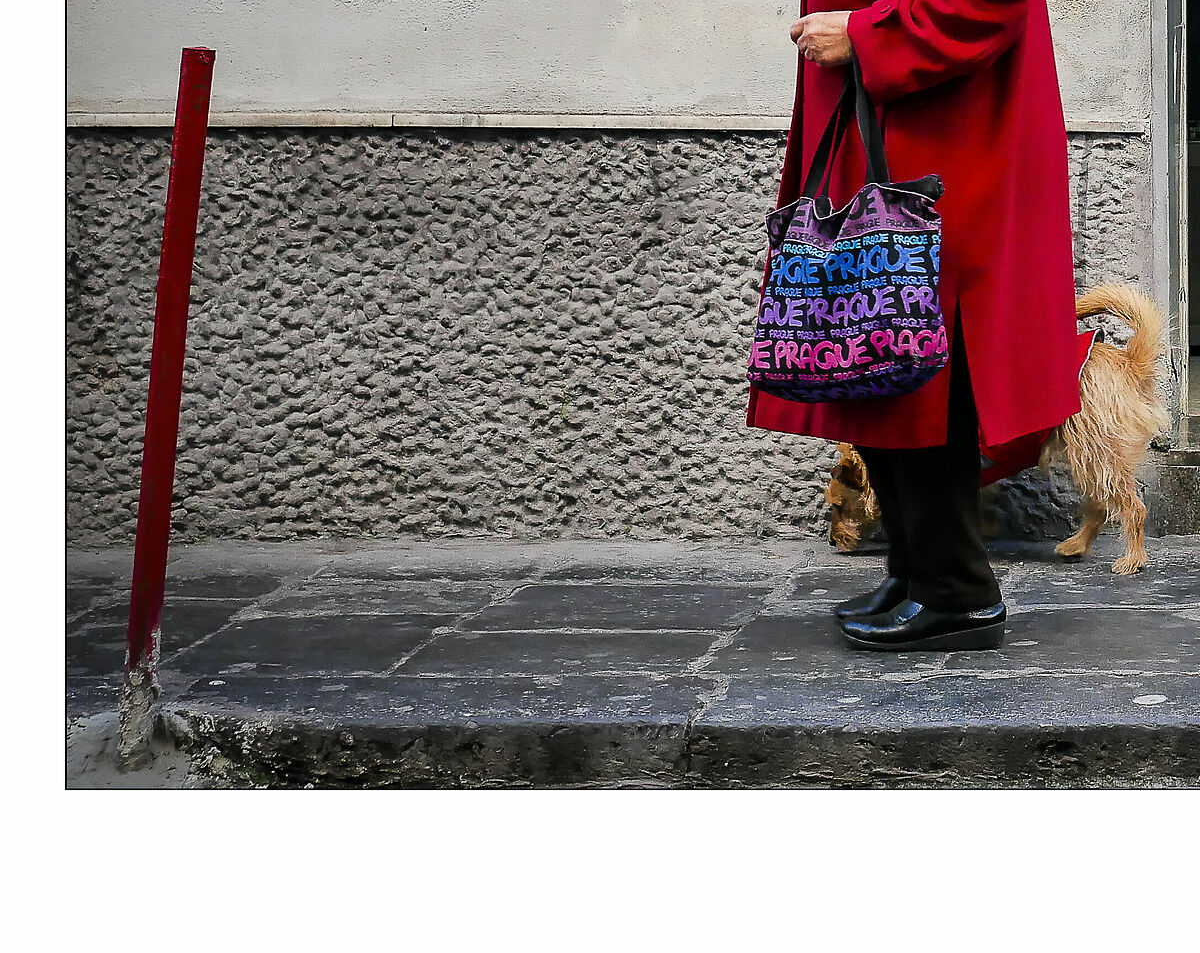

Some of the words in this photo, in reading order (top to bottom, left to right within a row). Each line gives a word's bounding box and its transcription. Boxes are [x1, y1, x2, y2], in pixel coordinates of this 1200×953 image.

[893, 233, 929, 245] PRAGUE
[823, 243, 927, 282] PRAGUE
[891, 275, 929, 286] PRAGUE
[806, 285, 897, 327] PRAGUE
[774, 333, 873, 373] PRAGUE
